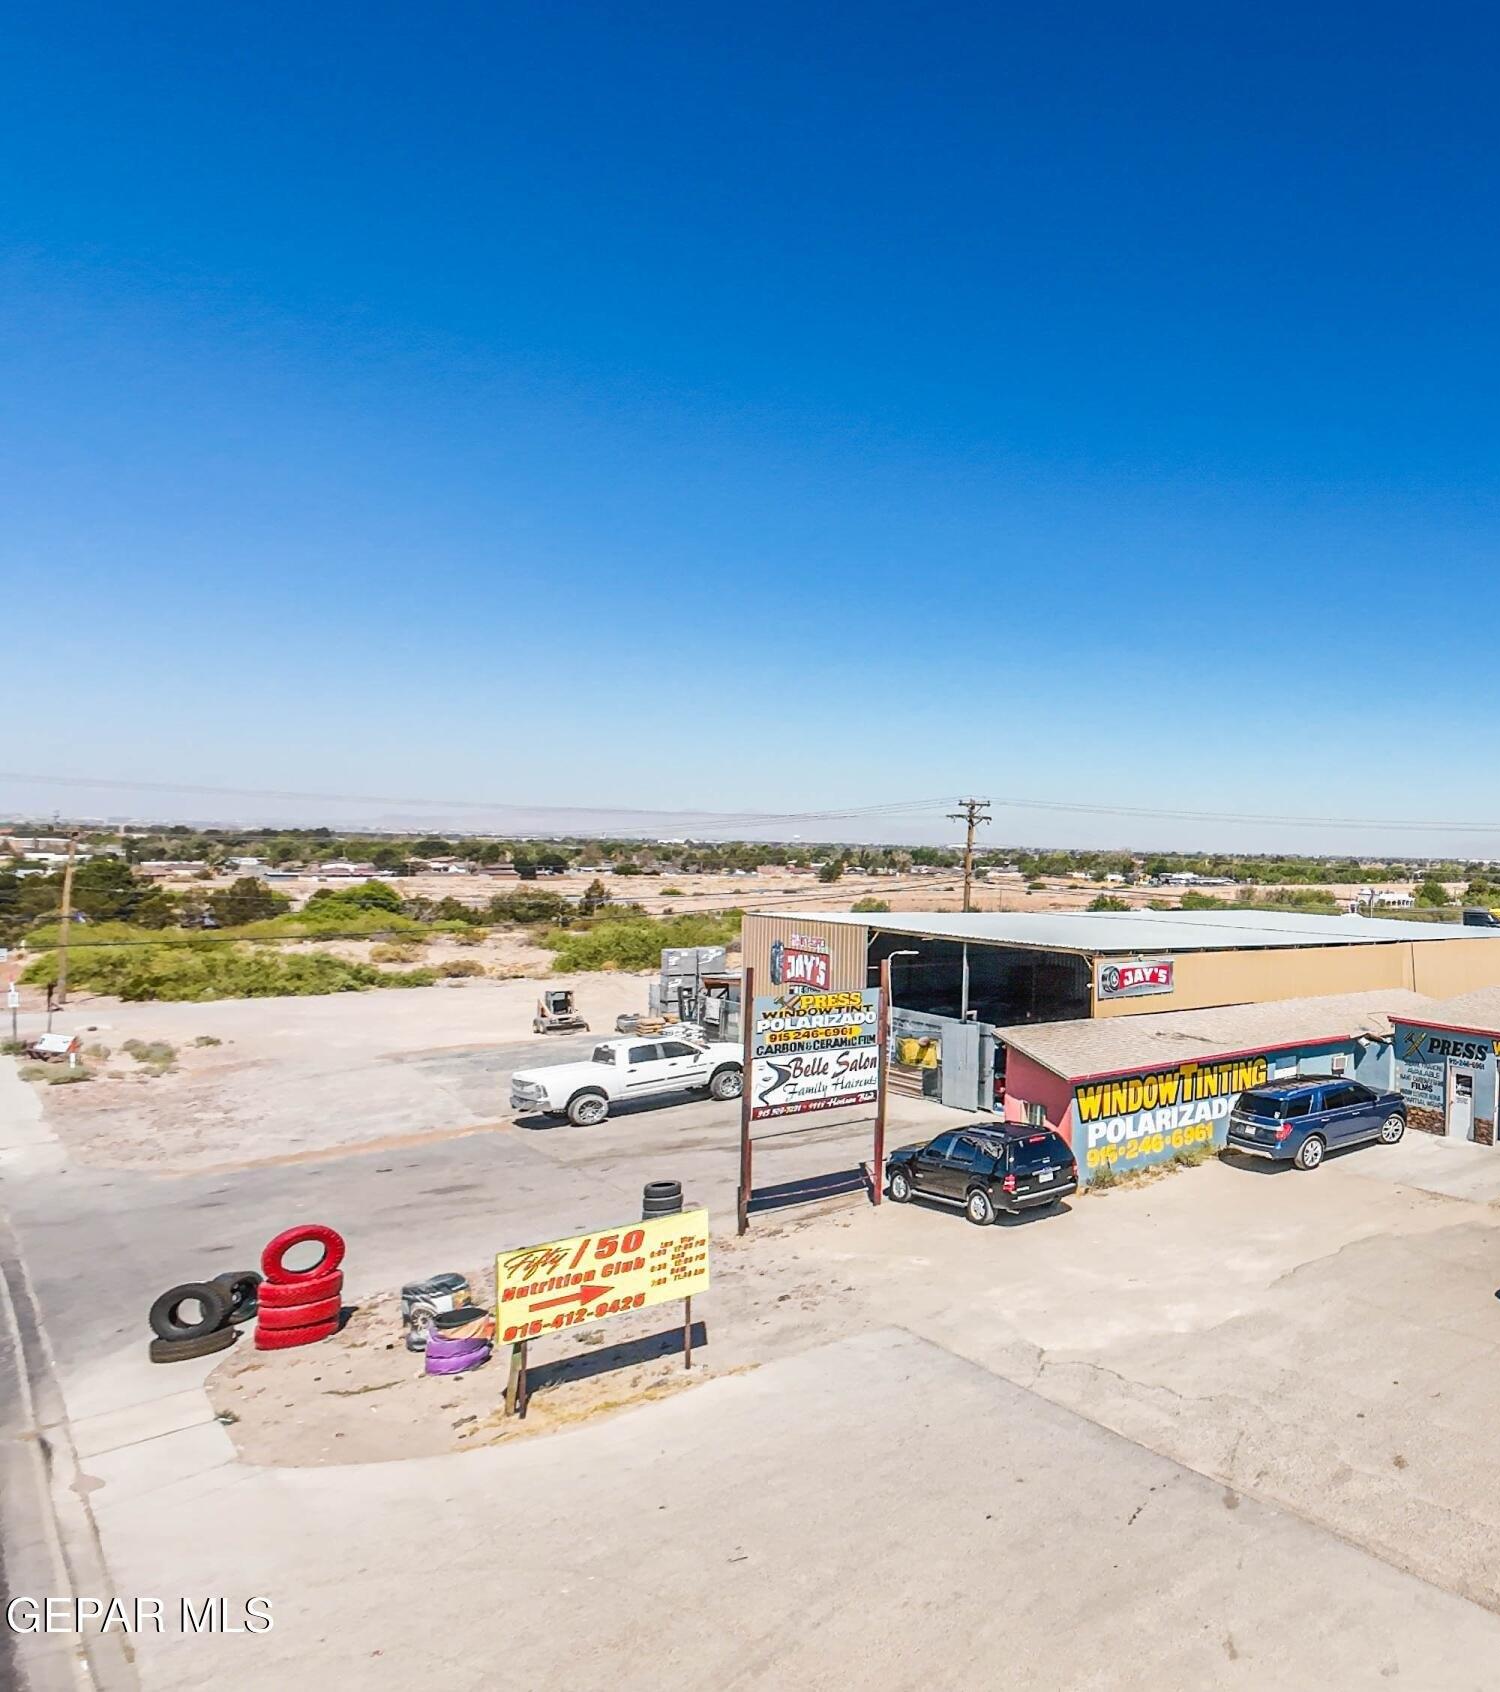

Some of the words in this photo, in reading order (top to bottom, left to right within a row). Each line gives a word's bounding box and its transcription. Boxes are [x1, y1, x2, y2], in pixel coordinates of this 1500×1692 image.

[787, 955, 827, 986] JAY'S
[1123, 968, 1168, 986] JAY'S
[756, 1012, 877, 1034] POLARIZADO
[788, 1057, 829, 1079] Belle
[831, 1051, 878, 1079] Salon
[783, 1082, 828, 1101] Family
[1411, 1081, 1433, 1092] FILMS
[504, 1248, 572, 1281] Fifty
[501, 1269, 596, 1302] Nutrition
[601, 1257, 645, 1278] Club
